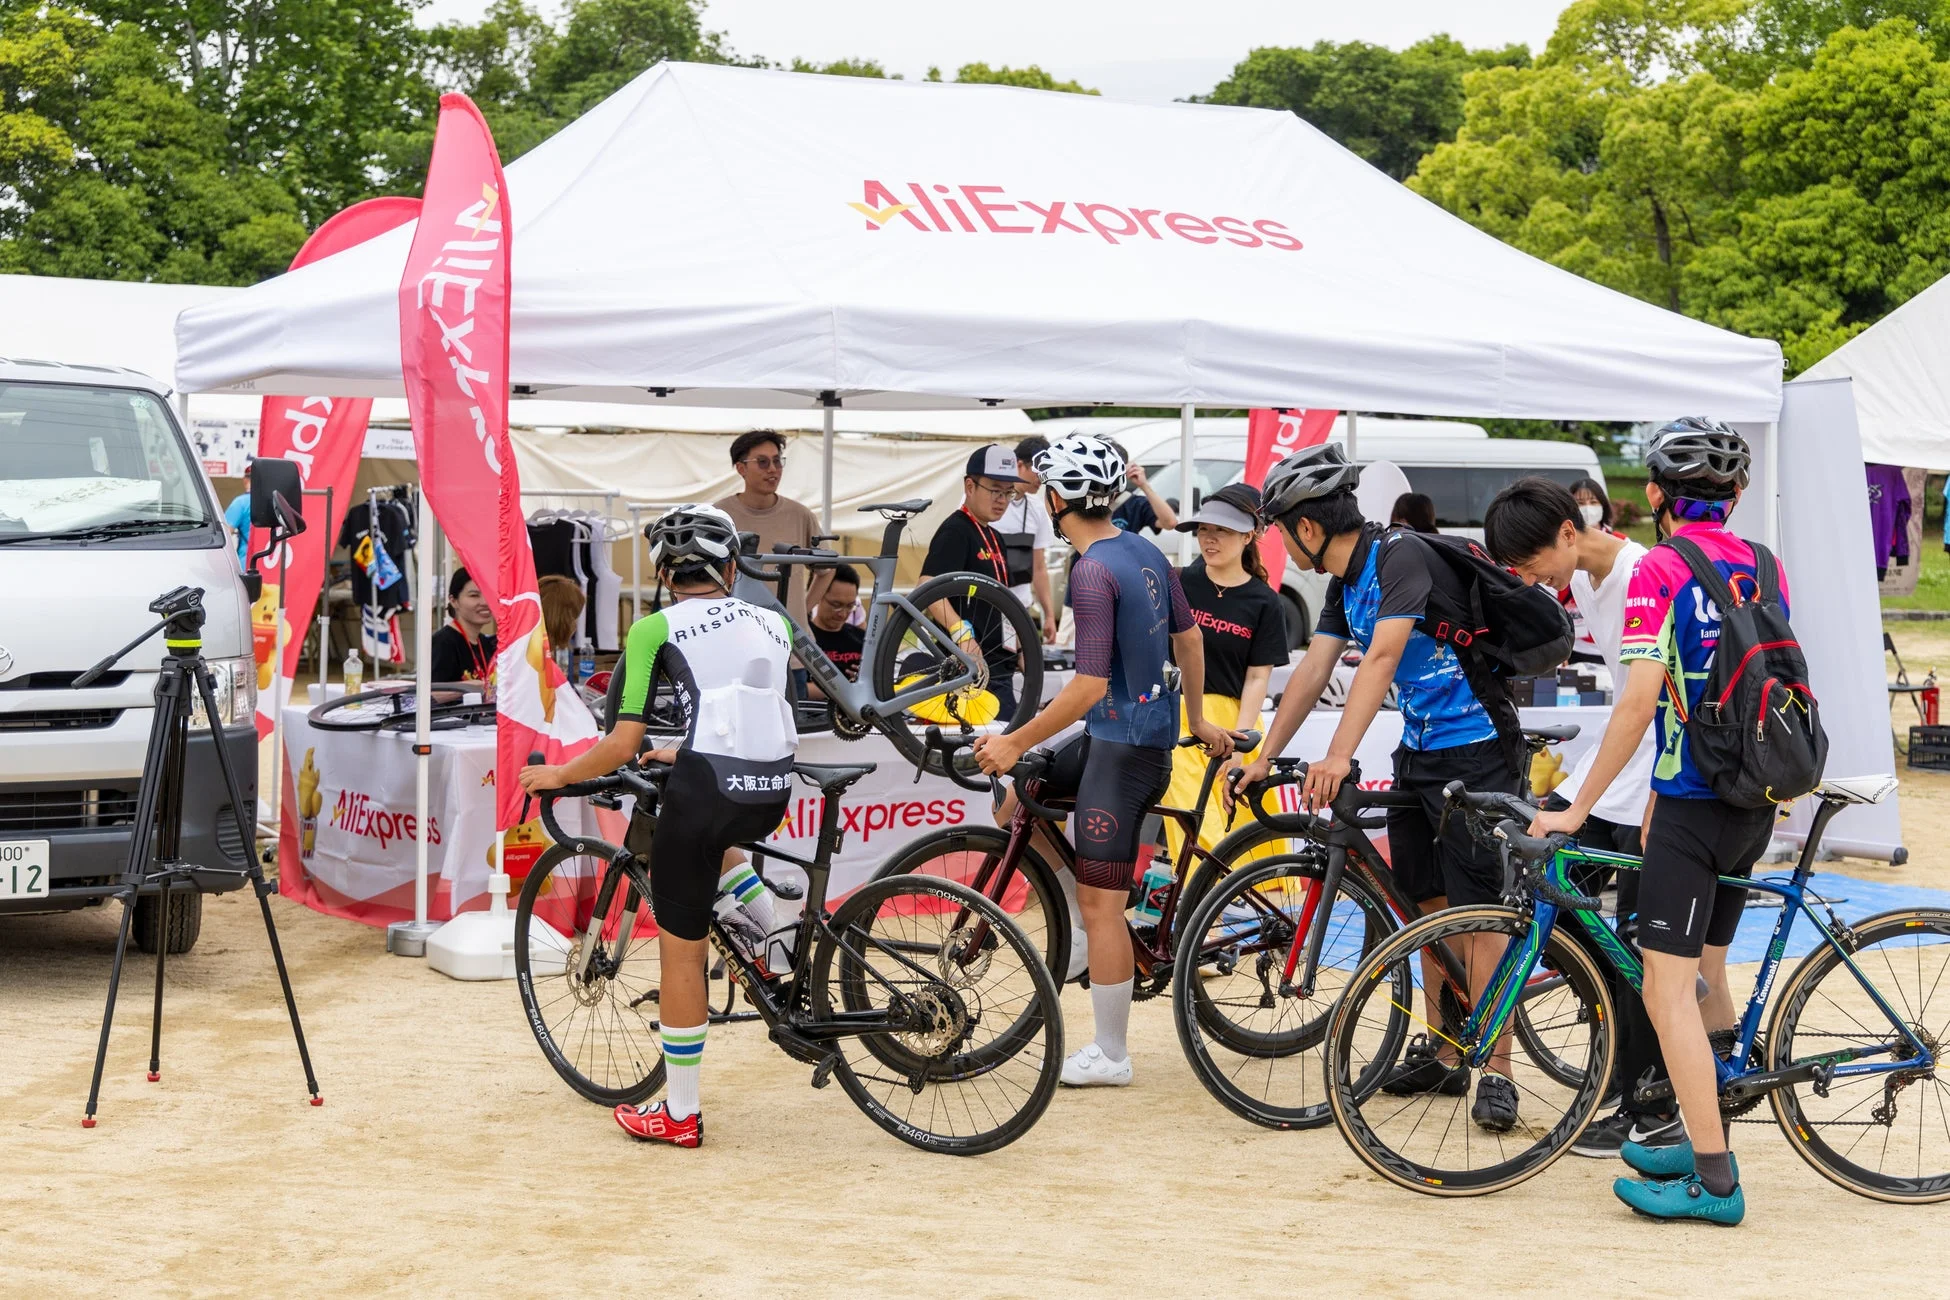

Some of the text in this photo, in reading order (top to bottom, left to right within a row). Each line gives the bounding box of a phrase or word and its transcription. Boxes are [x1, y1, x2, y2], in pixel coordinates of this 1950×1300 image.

[847, 179, 1304, 251] AliExpress
[773, 797, 966, 843] Alixpress
[1772, 940, 1787, 961] 400
[1757, 960, 1780, 1005] Kawasaki
[641, 1117, 667, 1136] 16
